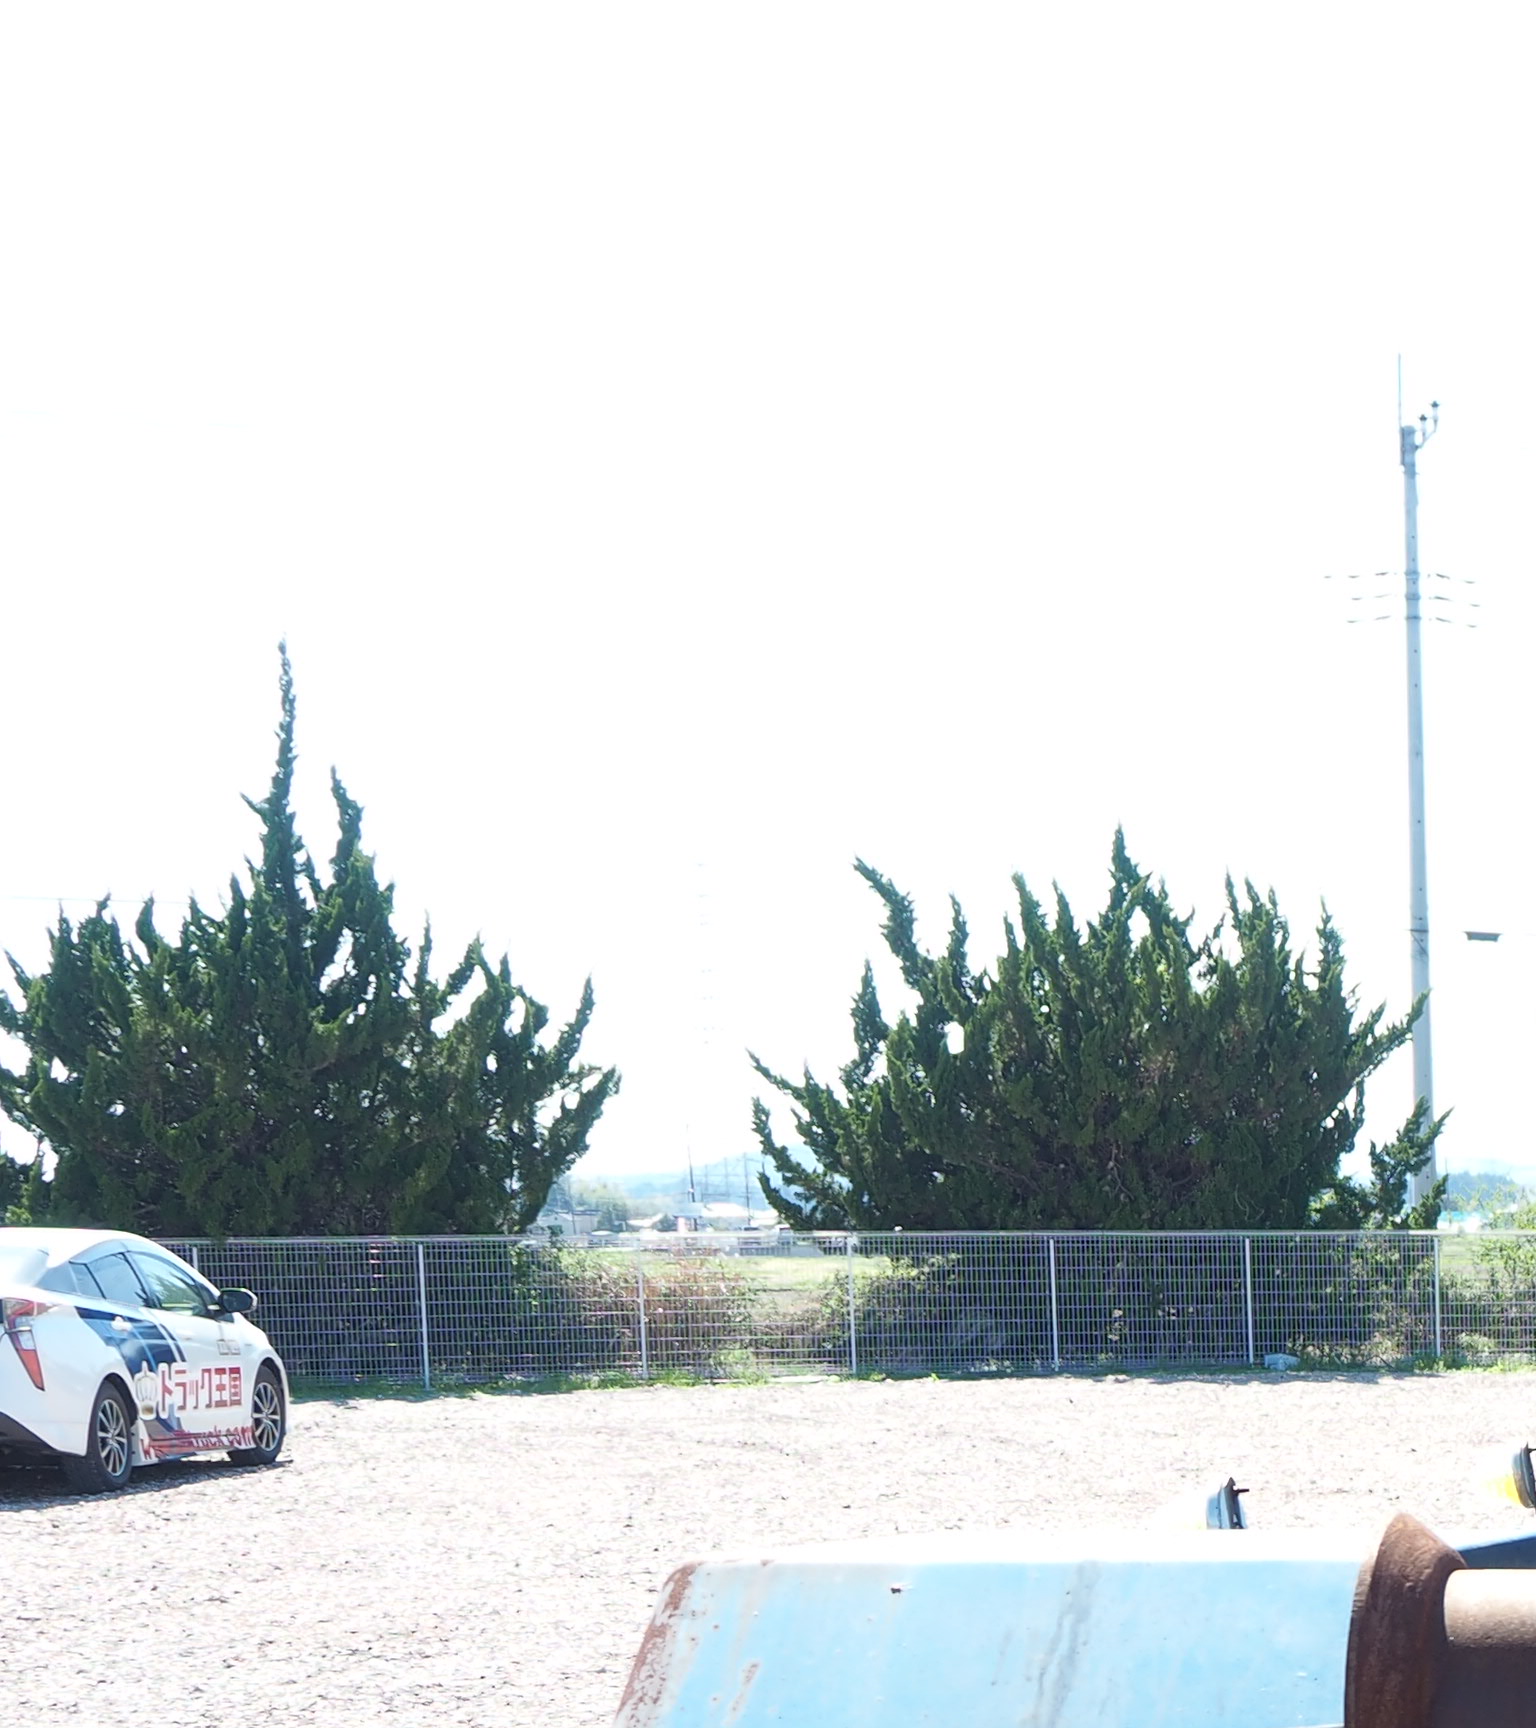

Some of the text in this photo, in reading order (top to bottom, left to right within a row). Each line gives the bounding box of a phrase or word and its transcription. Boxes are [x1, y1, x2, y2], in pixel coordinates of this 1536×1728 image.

[161, 1366, 242, 1412] トラック王国
